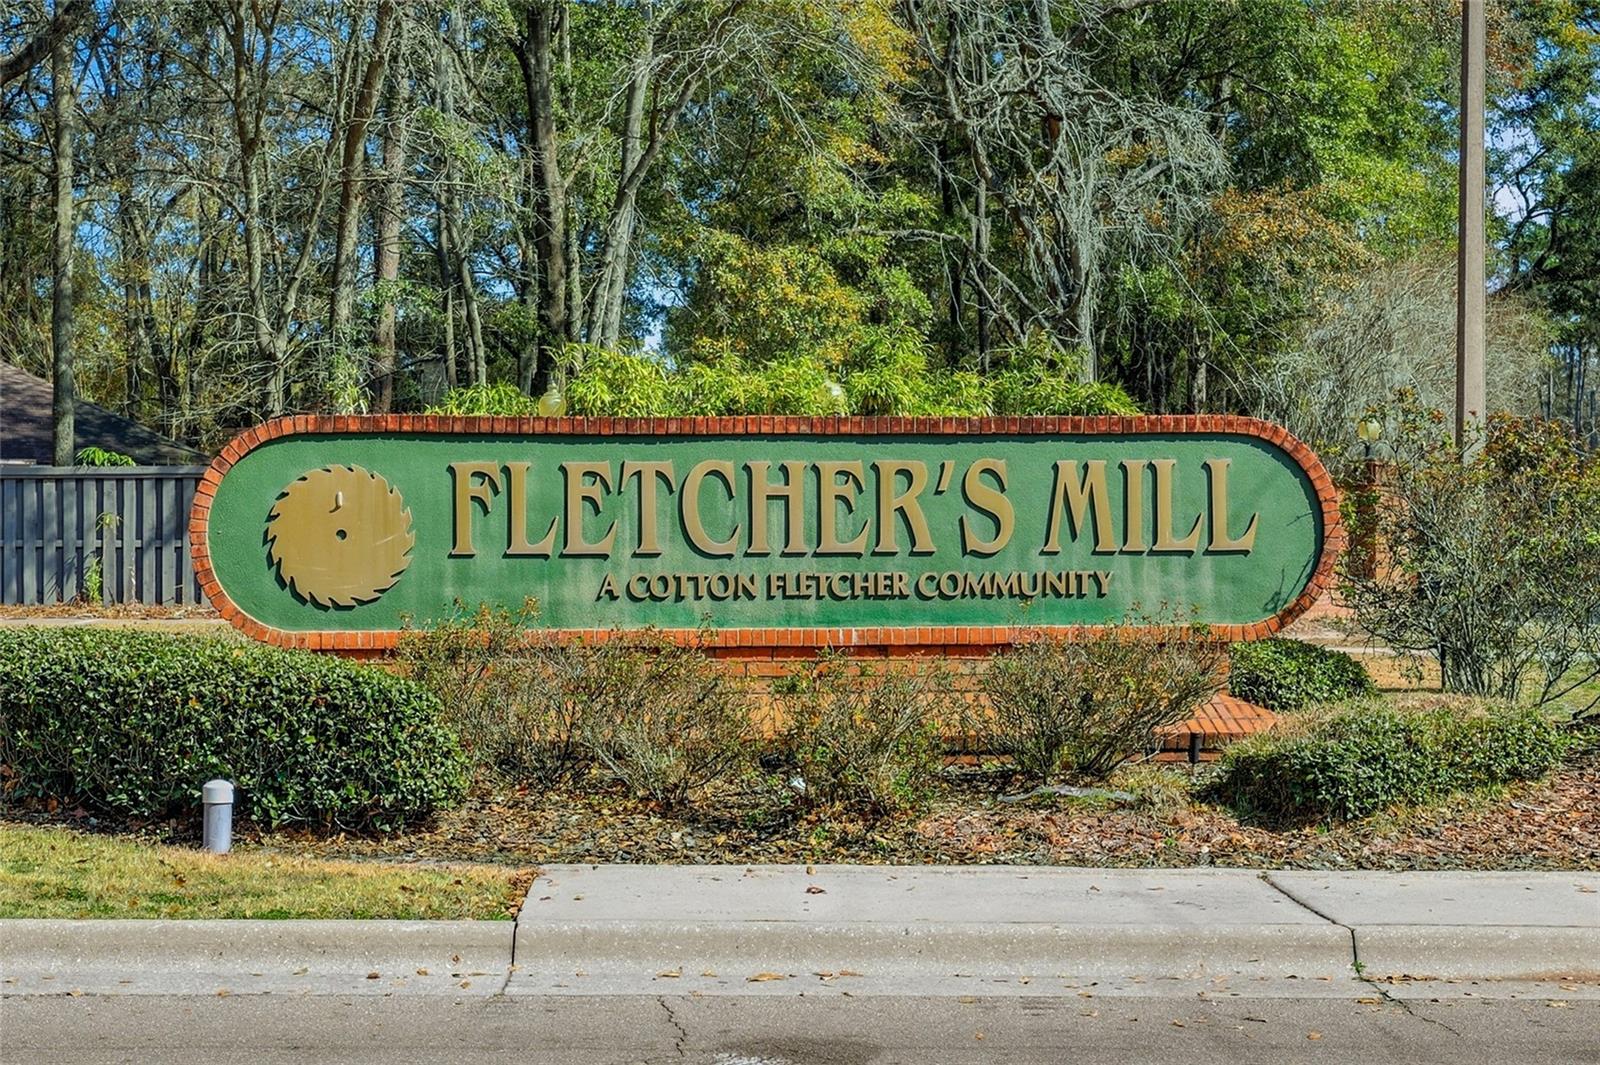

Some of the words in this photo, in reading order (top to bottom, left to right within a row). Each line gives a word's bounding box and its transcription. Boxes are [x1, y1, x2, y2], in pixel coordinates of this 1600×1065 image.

[449, 458, 1015, 557] FLETCHER'S
[1042, 458, 1260, 556] MILL
[598, 572, 621, 599] A
[627, 572, 759, 600] COTTON
[769, 571, 910, 599] FLETCHER
[916, 570, 1113, 599] COMMUNITY
